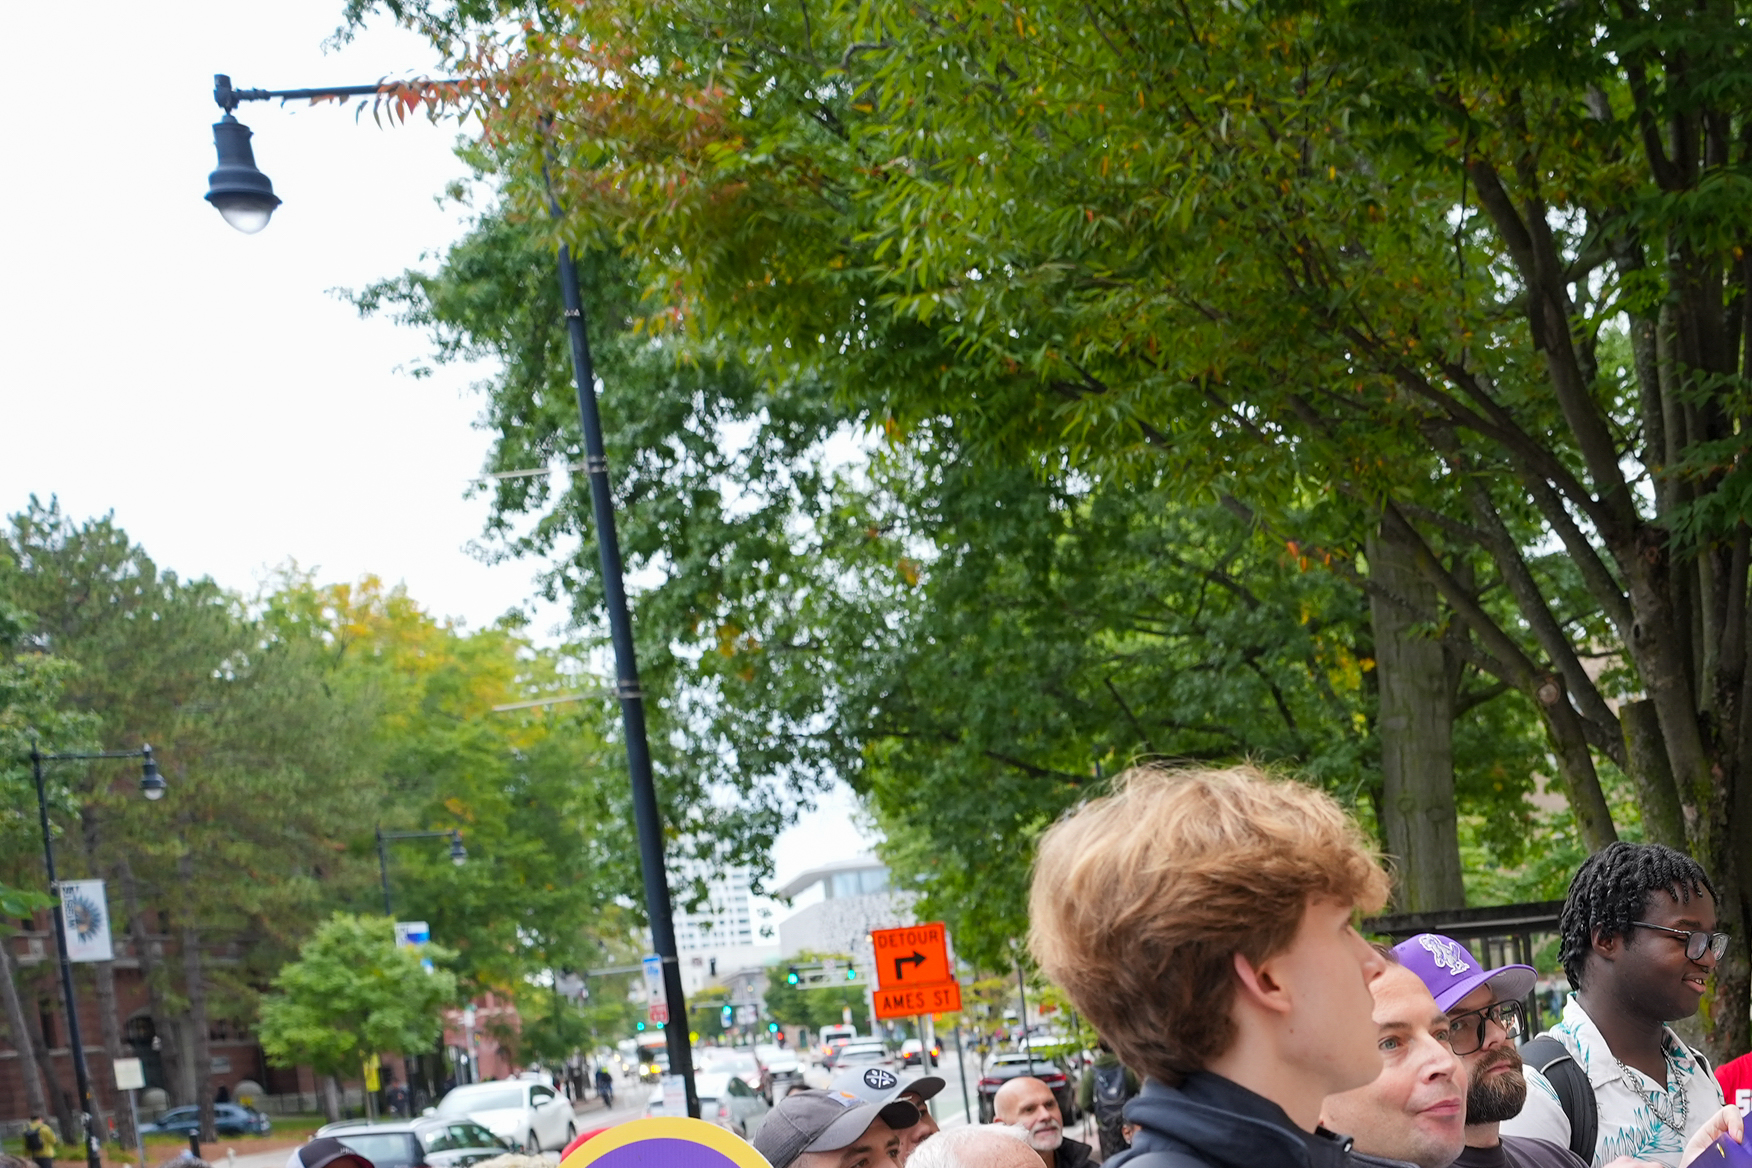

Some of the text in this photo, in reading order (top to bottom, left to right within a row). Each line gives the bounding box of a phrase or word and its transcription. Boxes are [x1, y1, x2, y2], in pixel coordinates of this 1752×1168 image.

[877, 929, 939, 949] DETOUR
[883, 989, 950, 1012] AMES ST
